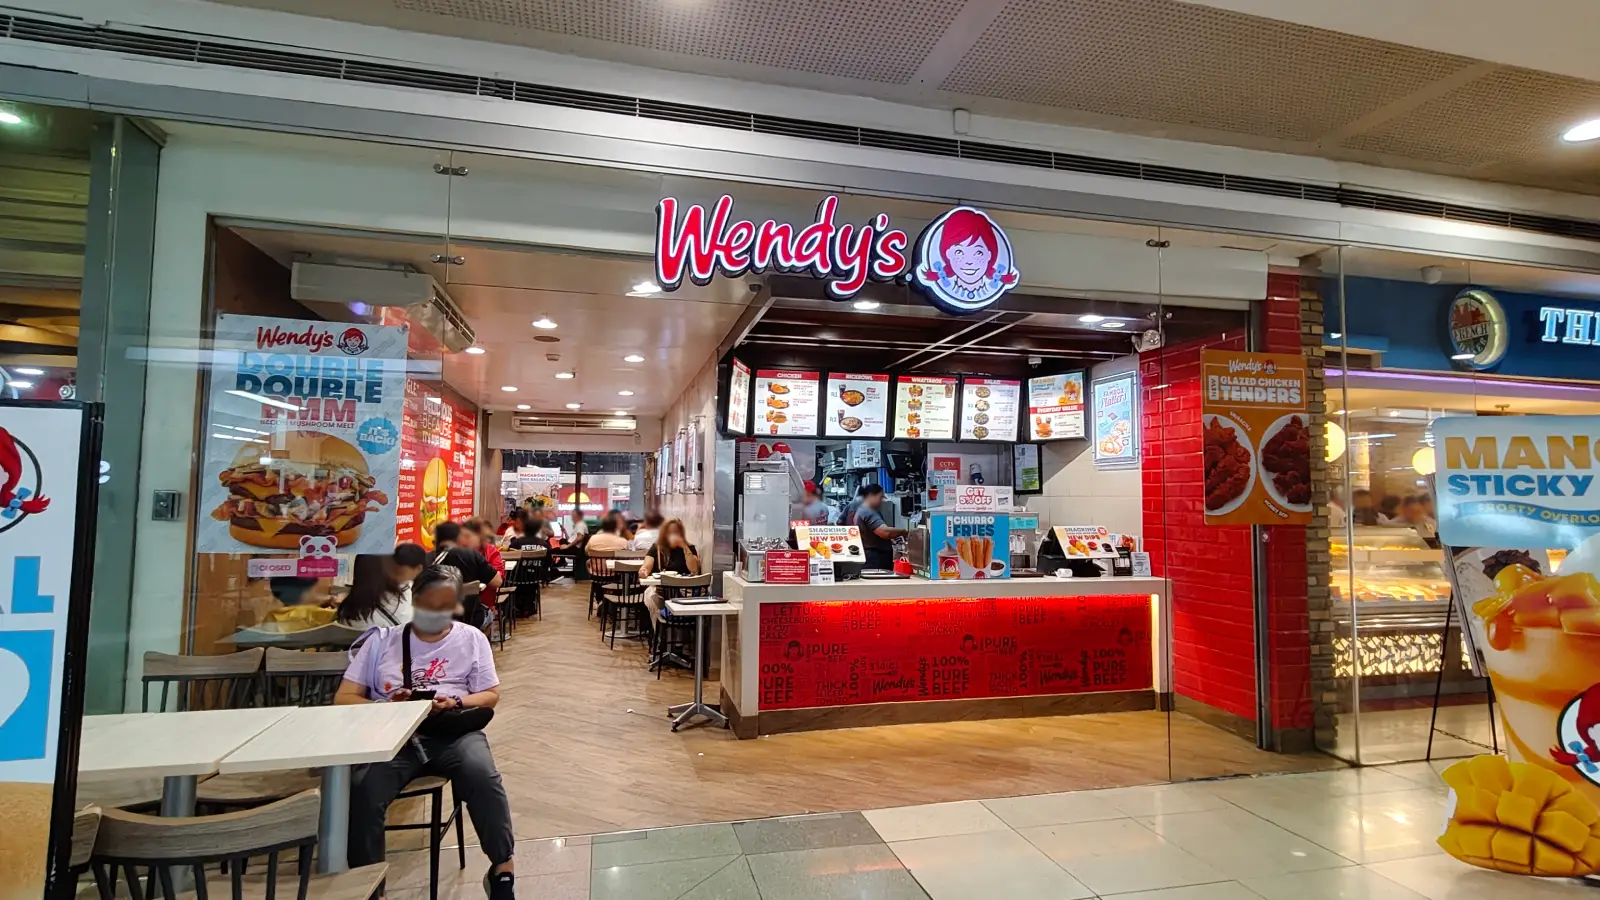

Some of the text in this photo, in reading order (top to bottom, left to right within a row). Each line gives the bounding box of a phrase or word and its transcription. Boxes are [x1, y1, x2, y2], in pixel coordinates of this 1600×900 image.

[656, 194, 909, 298] Wendy's
[256, 325, 334, 353] Wendy's
[237, 352, 384, 382] DOUBLE
[1228, 358, 1262, 374] Wendy's
[1220, 375, 1300, 388] GLAZED CHICKEN
[236, 373, 383, 404] DOUBLE
[1220, 385, 1301, 404] TENDERS
[261, 396, 357, 423] BMM
[289, 419, 335, 428] MUSHROOM
[336, 421, 356, 429] MELT
[358, 432, 396, 445] BACK!
[966, 486, 985, 497] GET
[1447, 474, 1594, 497] STICKY
[975, 496, 992, 506] OFF
[1477, 503, 1536, 516] FROSTY
[953, 516, 995, 525] CHURRO
[953, 524, 994, 537] FRIES
[258, 564, 292, 572] CLOSED
[773, 606, 827, 616] LETTUCE
[851, 610, 881, 619] PURE
[761, 616, 827, 625] CHEESEBURGER
[851, 620, 880, 630] BEEF
[812, 643, 850, 655] PURE
[984, 636, 1018, 649] PURE
[1091, 648, 1126, 659] 100%
[932, 656, 969, 667] 100%
[1092, 660, 1127, 673] PURE
[849, 658, 860, 699] 100%
[932, 668, 970, 681] PURE
[1093, 672, 1127, 686] BEEF
[759, 676, 795, 690] URE
[815, 680, 848, 690] THICK
[932, 680, 970, 696] BEEF
[758, 690, 795, 705] EEF
